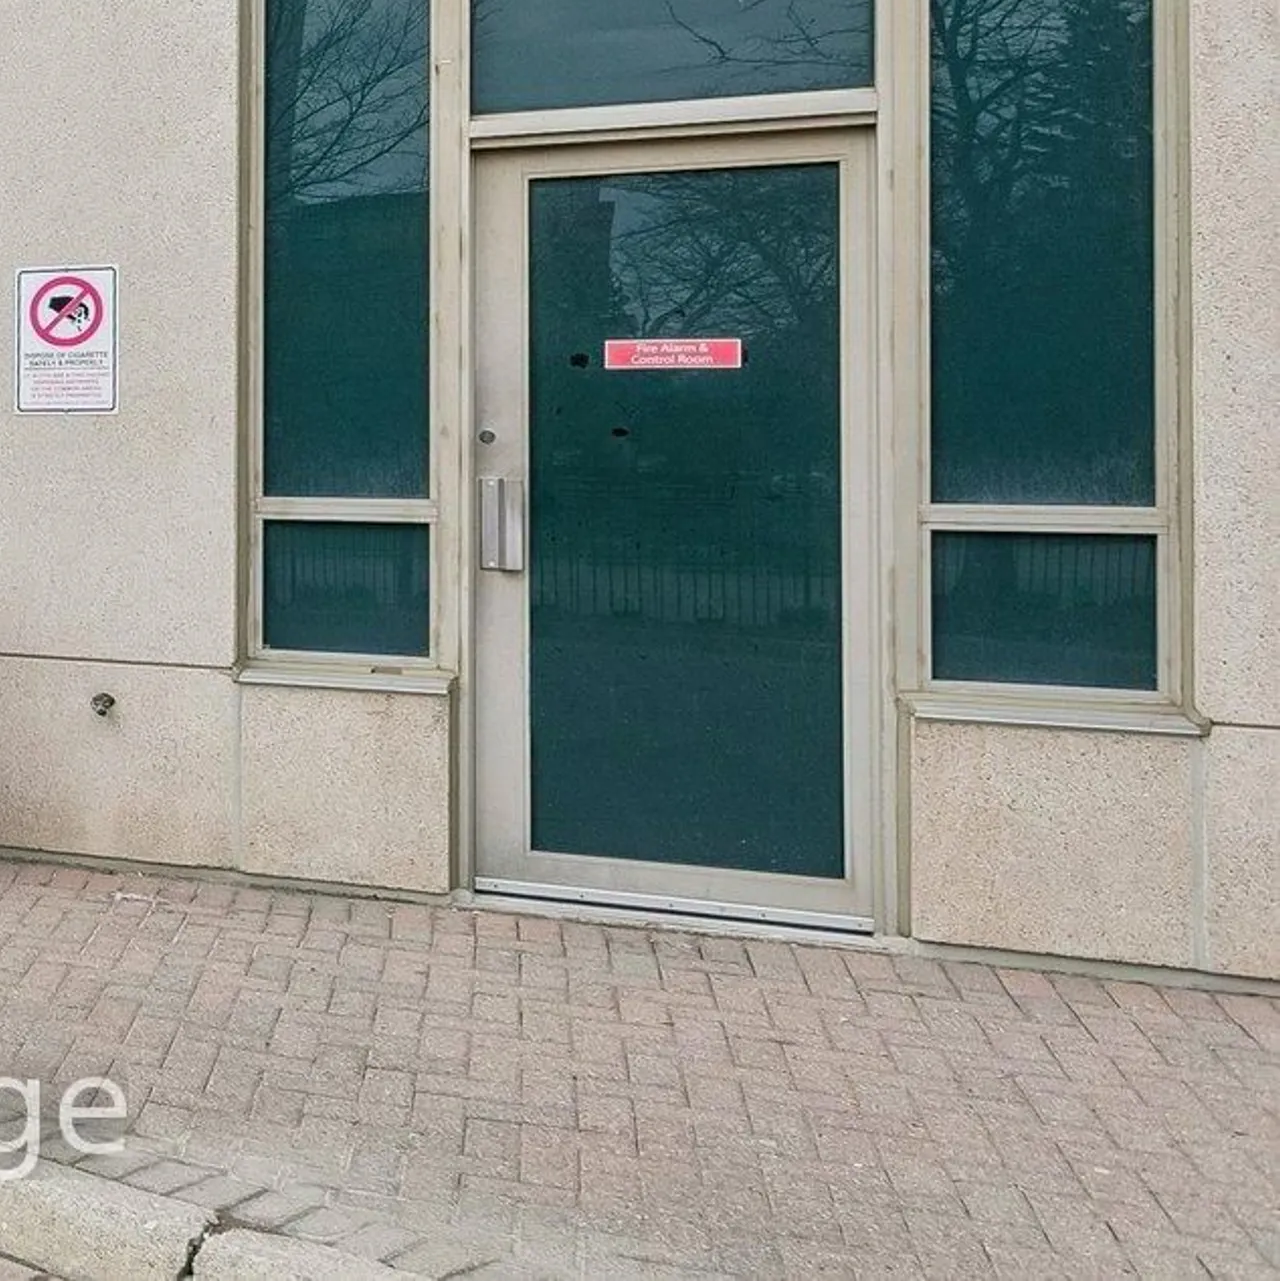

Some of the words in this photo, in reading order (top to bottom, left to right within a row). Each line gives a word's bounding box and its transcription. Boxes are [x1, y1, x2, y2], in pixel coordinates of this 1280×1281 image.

[636, 343, 658, 354] Fire
[660, 342, 697, 354] Alarm
[698, 342, 709, 353] &
[68, 351, 108, 359] CIGARETTE
[631, 355, 675, 365] Control
[677, 354, 714, 365] Room
